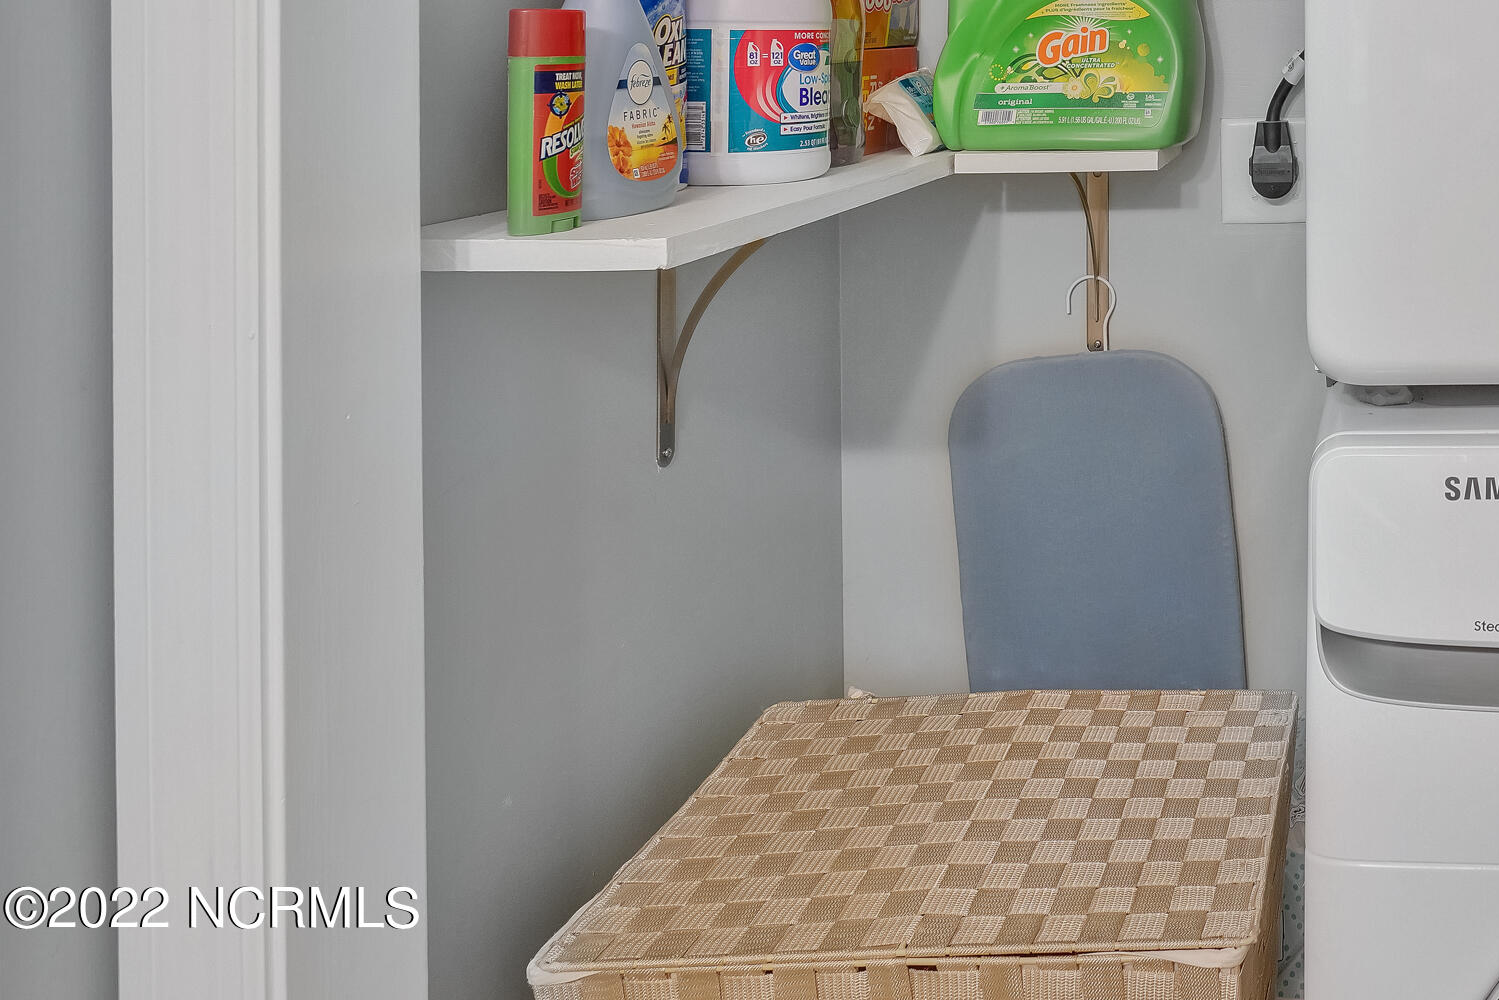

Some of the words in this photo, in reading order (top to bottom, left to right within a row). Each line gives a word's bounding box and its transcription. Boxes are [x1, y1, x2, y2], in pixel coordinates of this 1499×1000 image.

[794, 32, 814, 40] MORE
[1037, 27, 1109, 66] Gain
[749, 52, 758, 60] 81
[772, 52, 783, 60] 121
[793, 50, 816, 61] Great
[1066, 61, 1115, 69] CONCENTRATED
[555, 72, 571, 81] TREAT
[555, 81, 571, 90] WASH
[630, 74, 652, 91] febreze
[799, 87, 828, 107] Blea
[998, 98, 1033, 106] original
